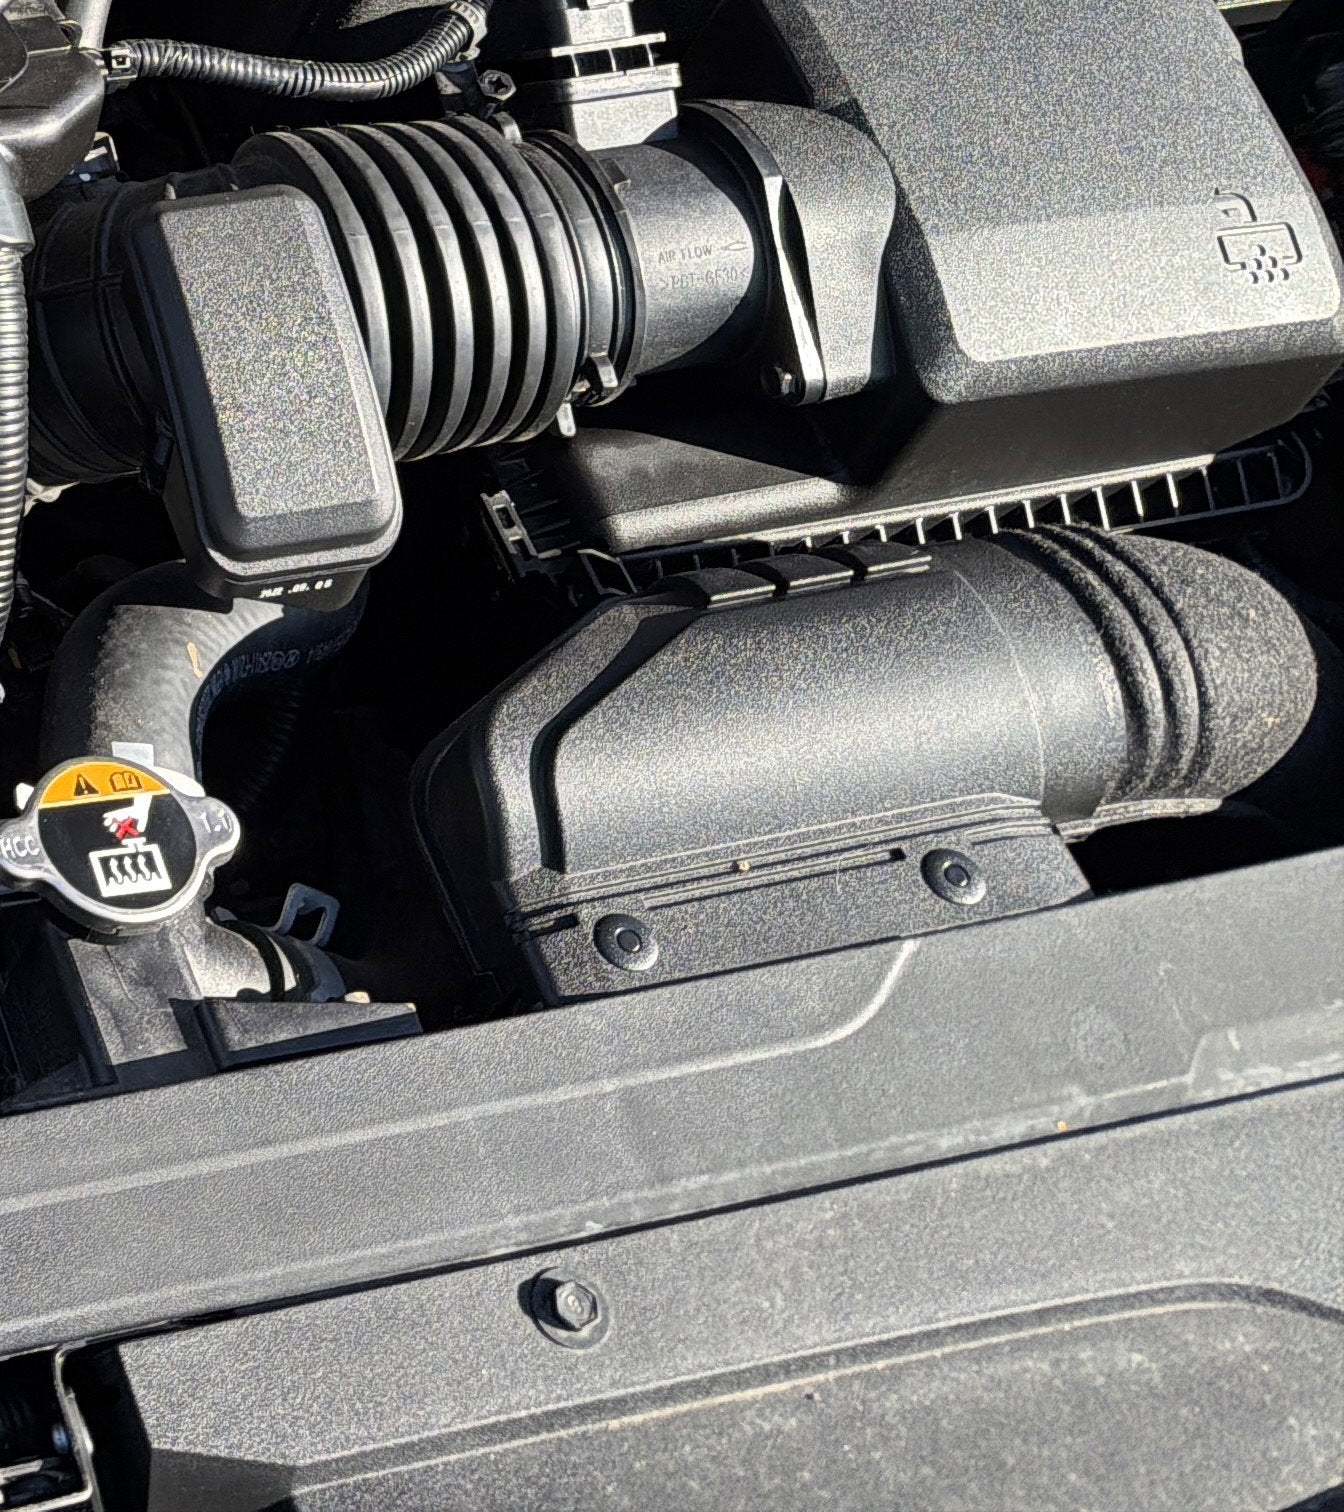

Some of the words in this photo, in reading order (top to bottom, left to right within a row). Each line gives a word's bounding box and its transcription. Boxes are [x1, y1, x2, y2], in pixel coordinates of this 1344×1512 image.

[658, 251, 676, 264] AIR
[681, 244, 713, 260] FLOW
[0, 833, 40, 858] HCC
